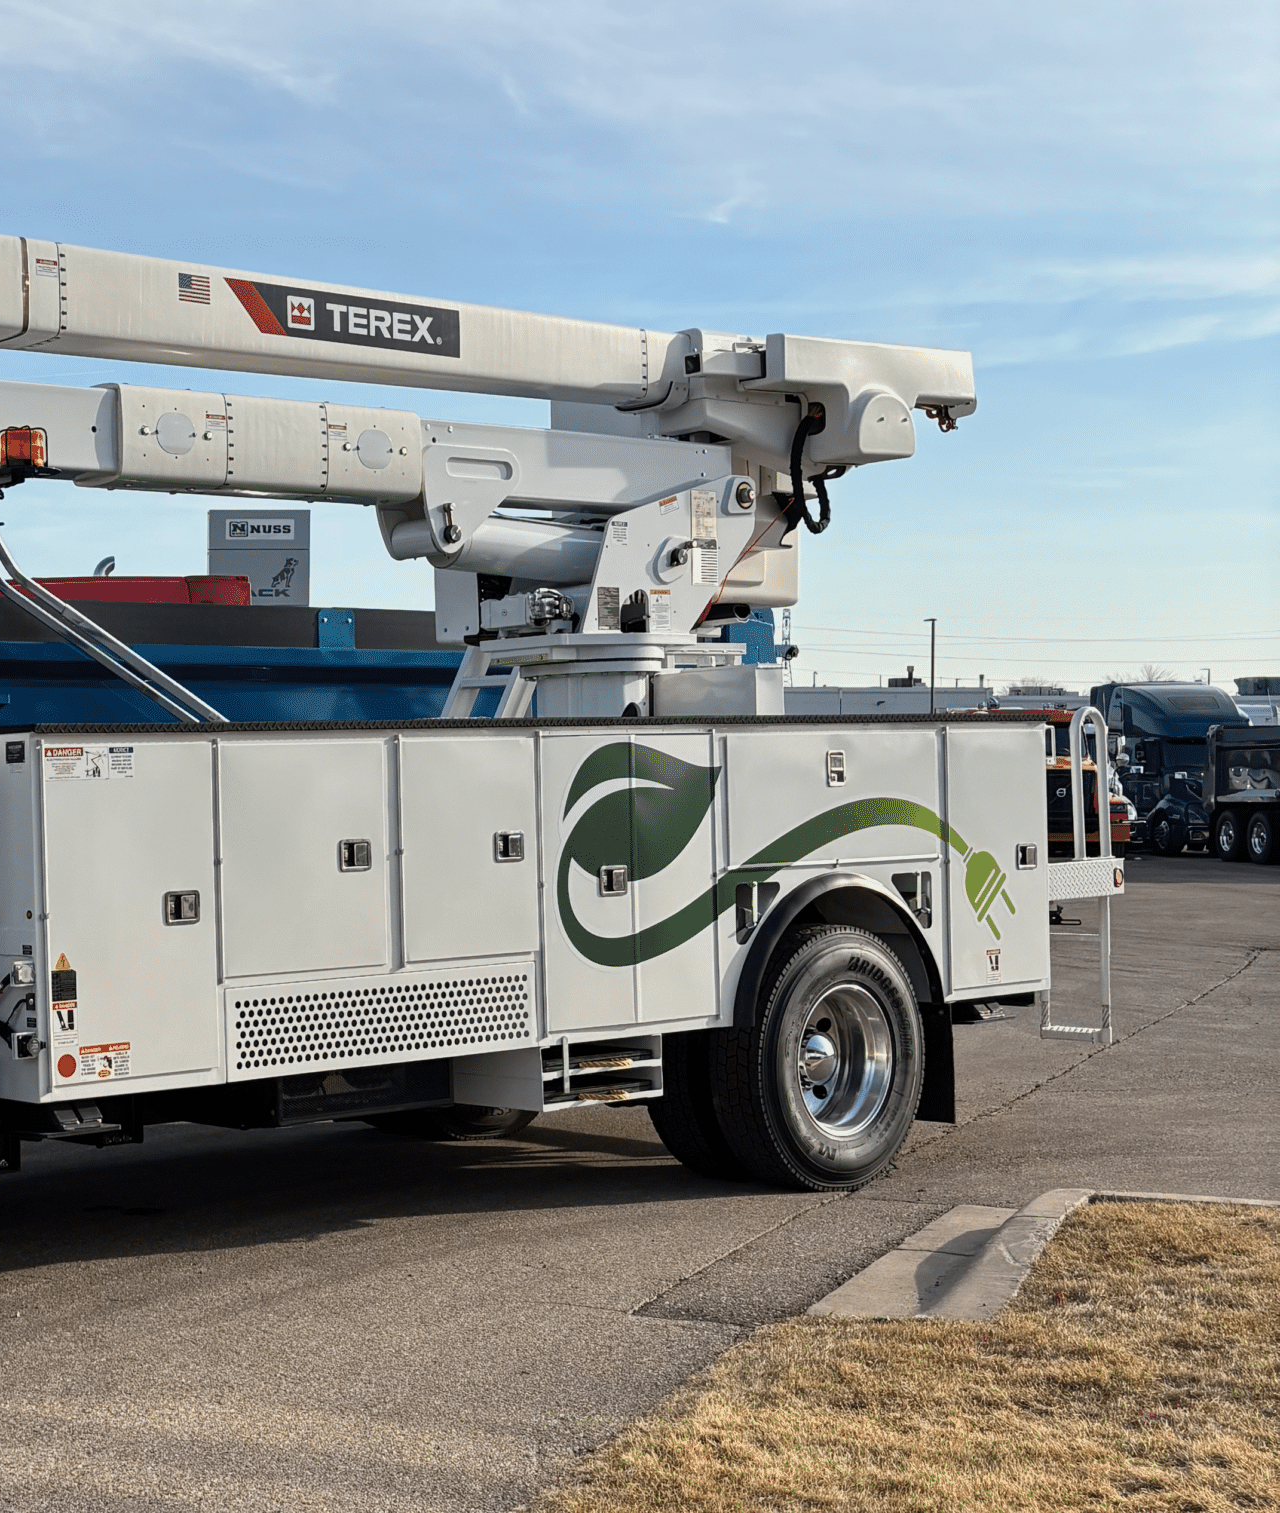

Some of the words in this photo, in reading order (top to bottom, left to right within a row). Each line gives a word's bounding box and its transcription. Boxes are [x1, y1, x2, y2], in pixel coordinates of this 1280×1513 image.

[325, 302, 435, 345] TEREX
[249, 525, 291, 534] NUSS
[53, 748, 82, 757] DANGER
